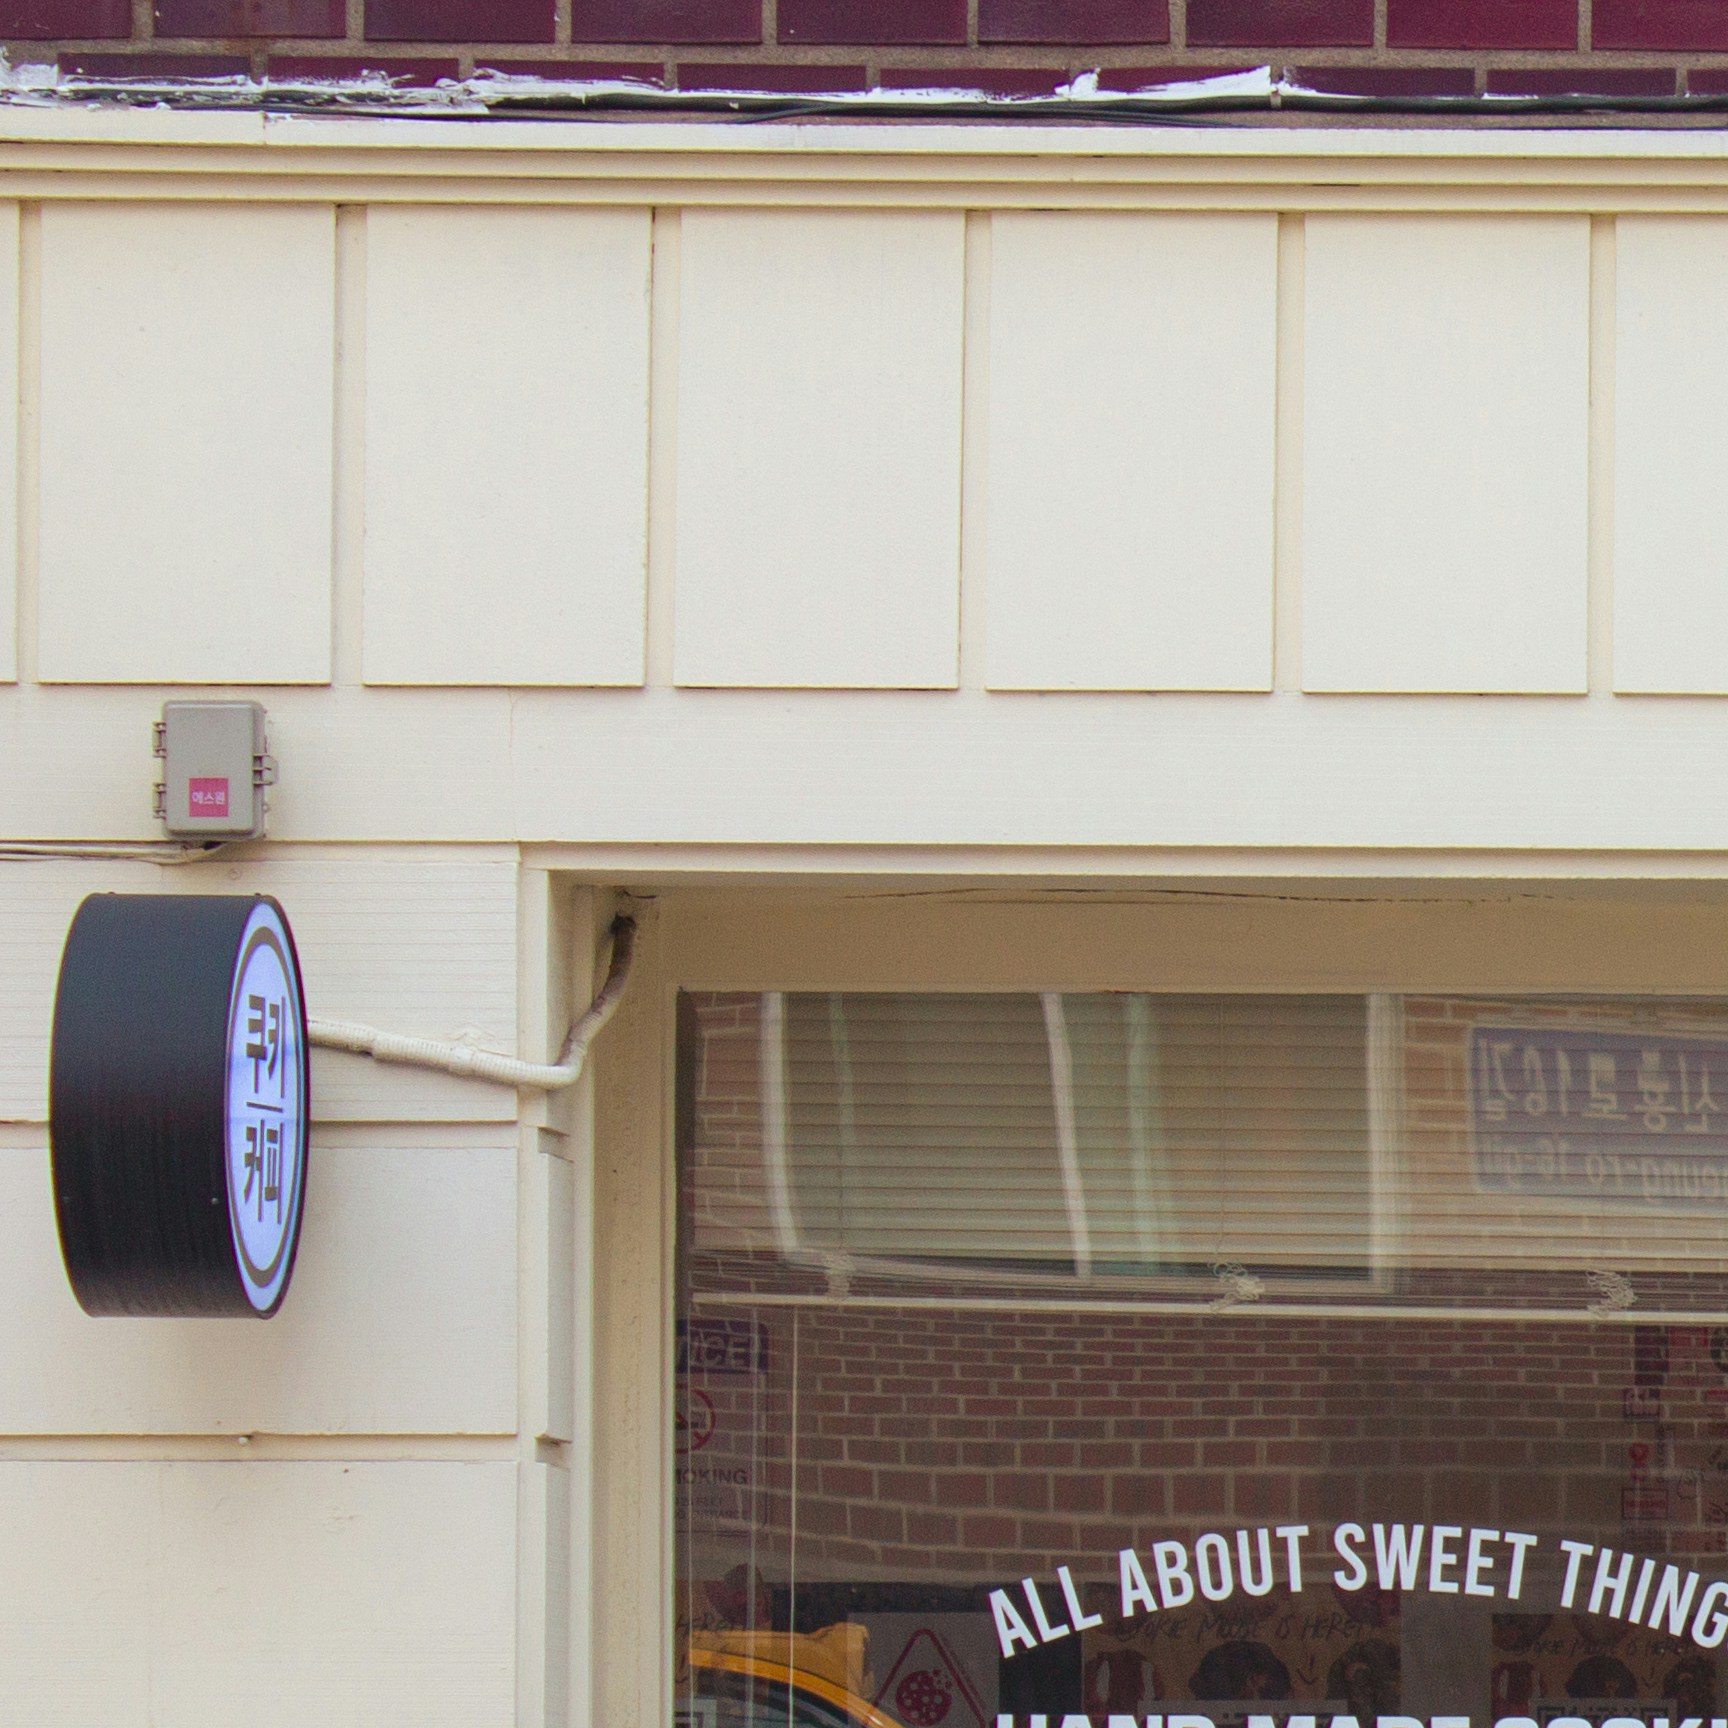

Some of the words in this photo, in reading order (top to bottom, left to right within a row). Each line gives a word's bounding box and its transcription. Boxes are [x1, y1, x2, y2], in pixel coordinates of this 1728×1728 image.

[988, 1565, 1103, 1659] ALL
[1119, 1525, 1310, 1619] ABOUT
[1333, 1522, 1538, 1600] SWEET
